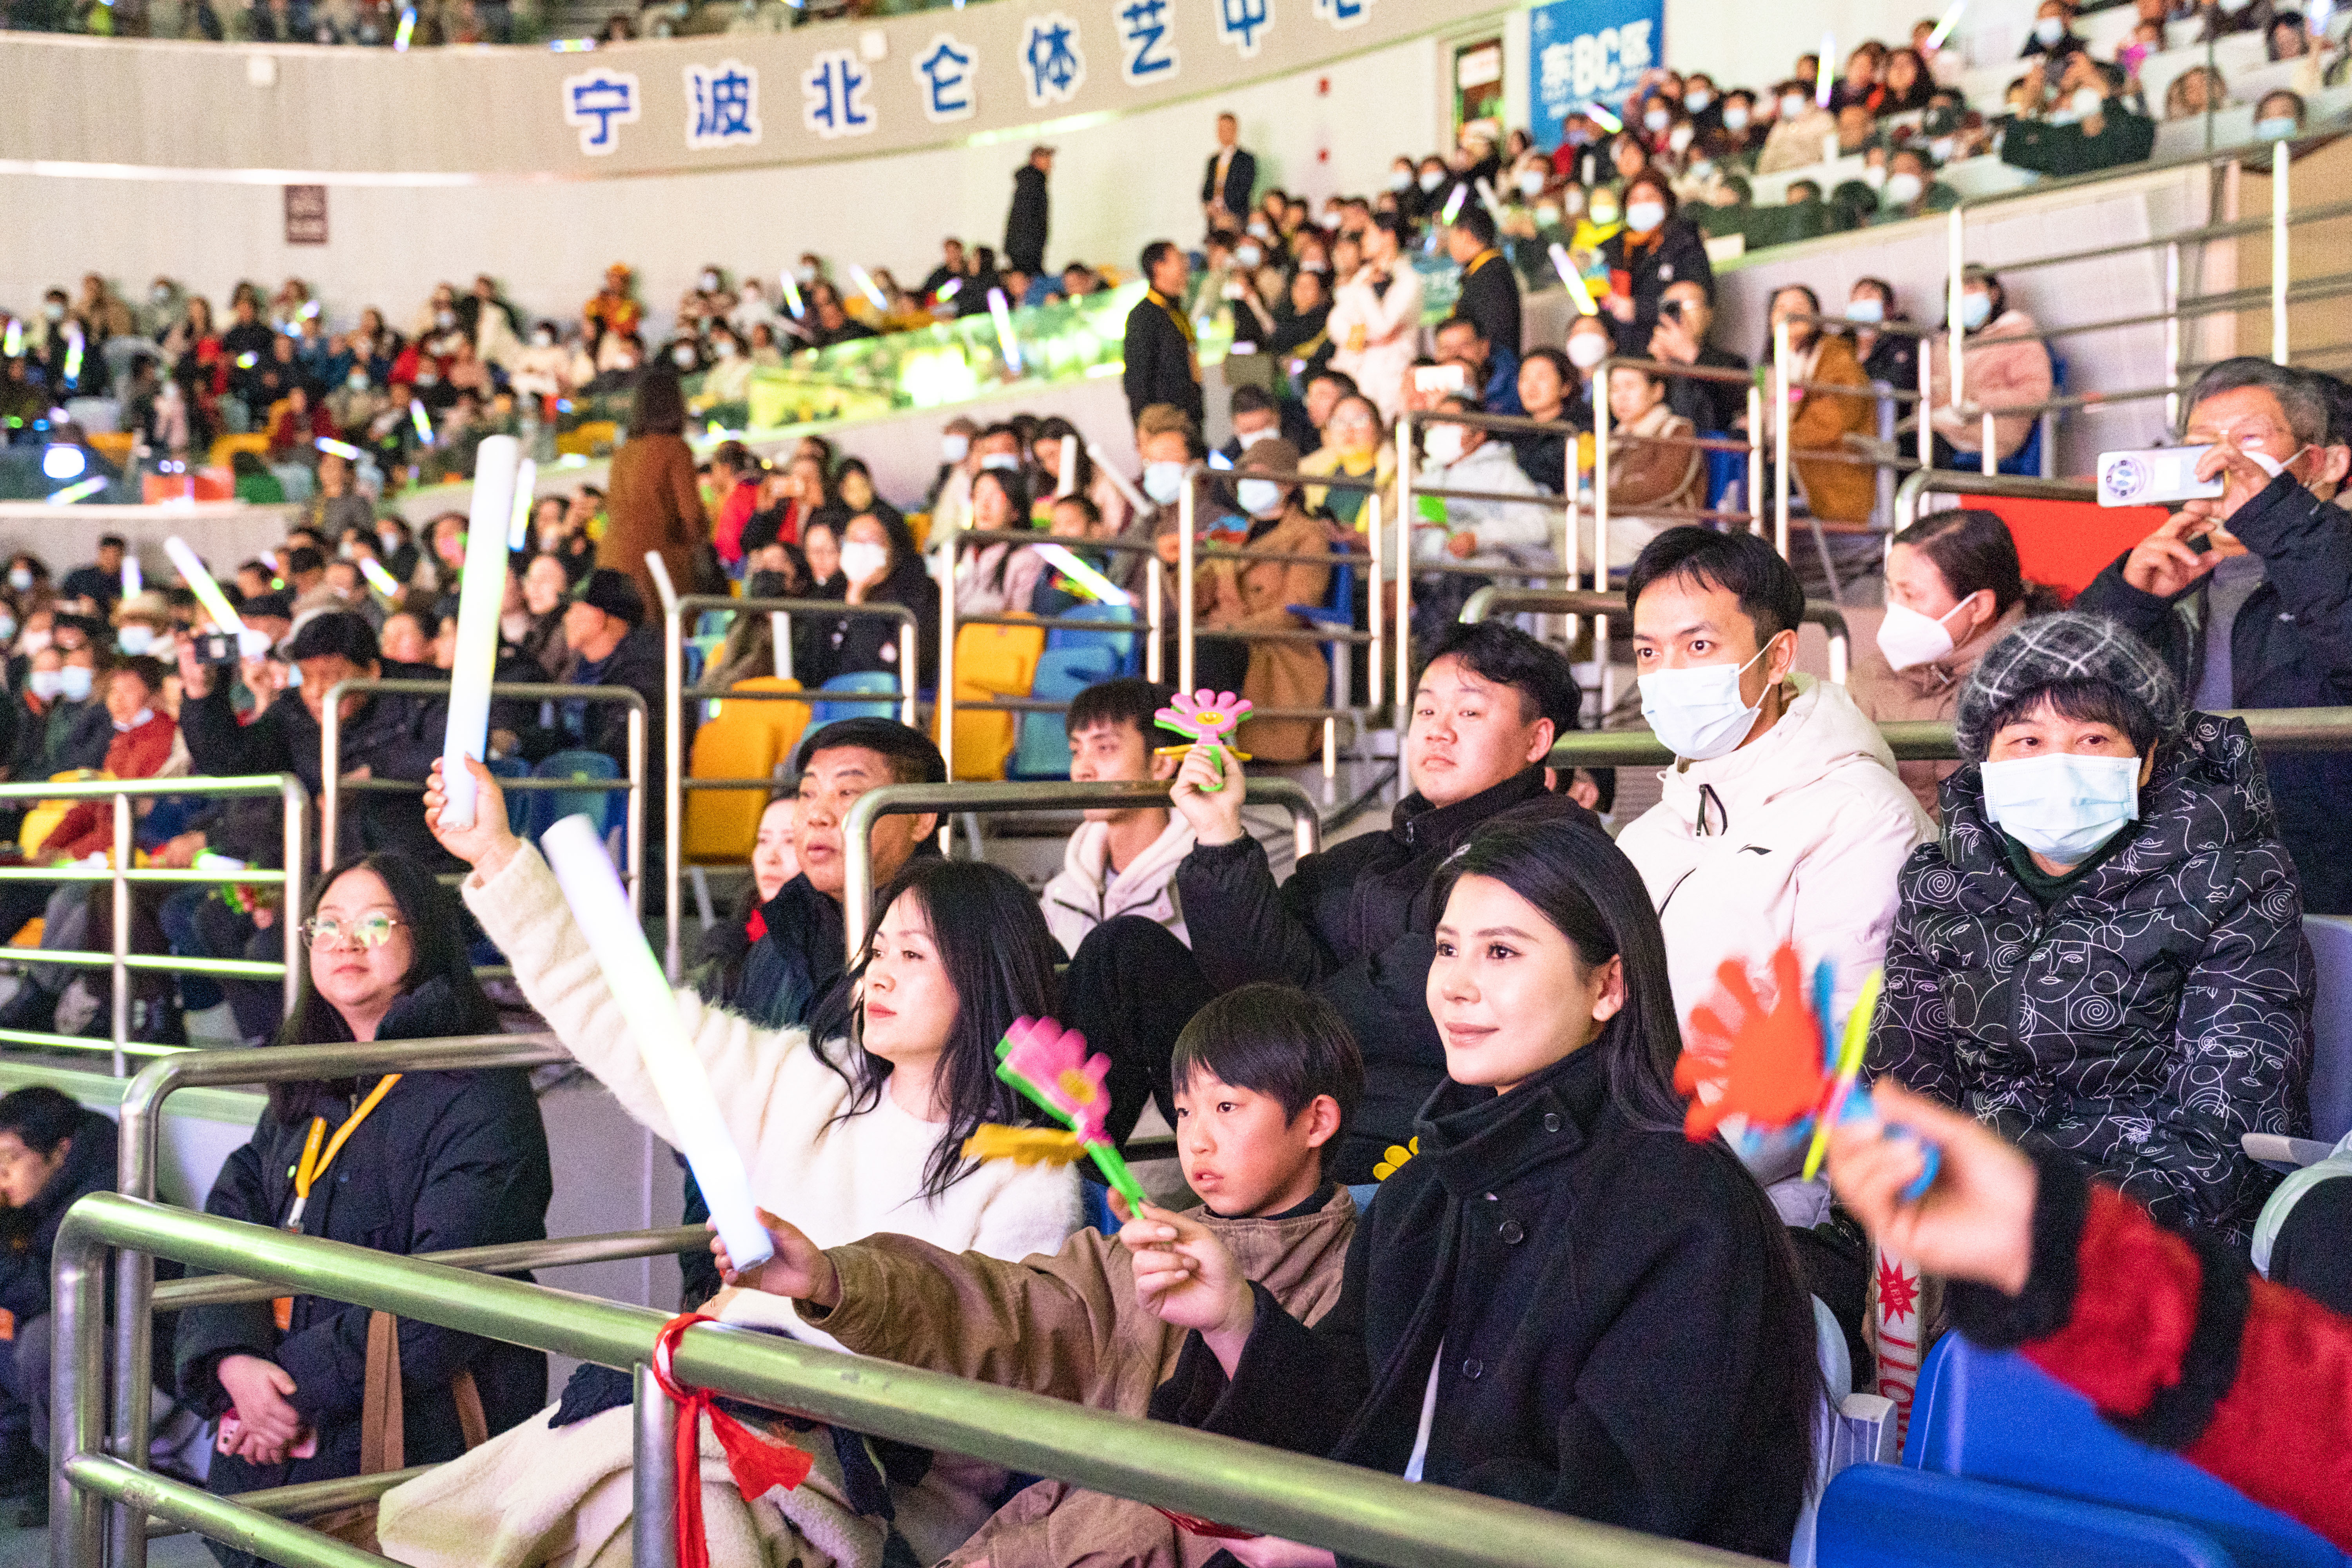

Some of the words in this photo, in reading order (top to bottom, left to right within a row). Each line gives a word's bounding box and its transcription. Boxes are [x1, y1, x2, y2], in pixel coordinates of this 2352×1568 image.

[573, 0, 1361, 144] 宁波北仑体艺中
[1887, 1280, 1903, 1306] LED
